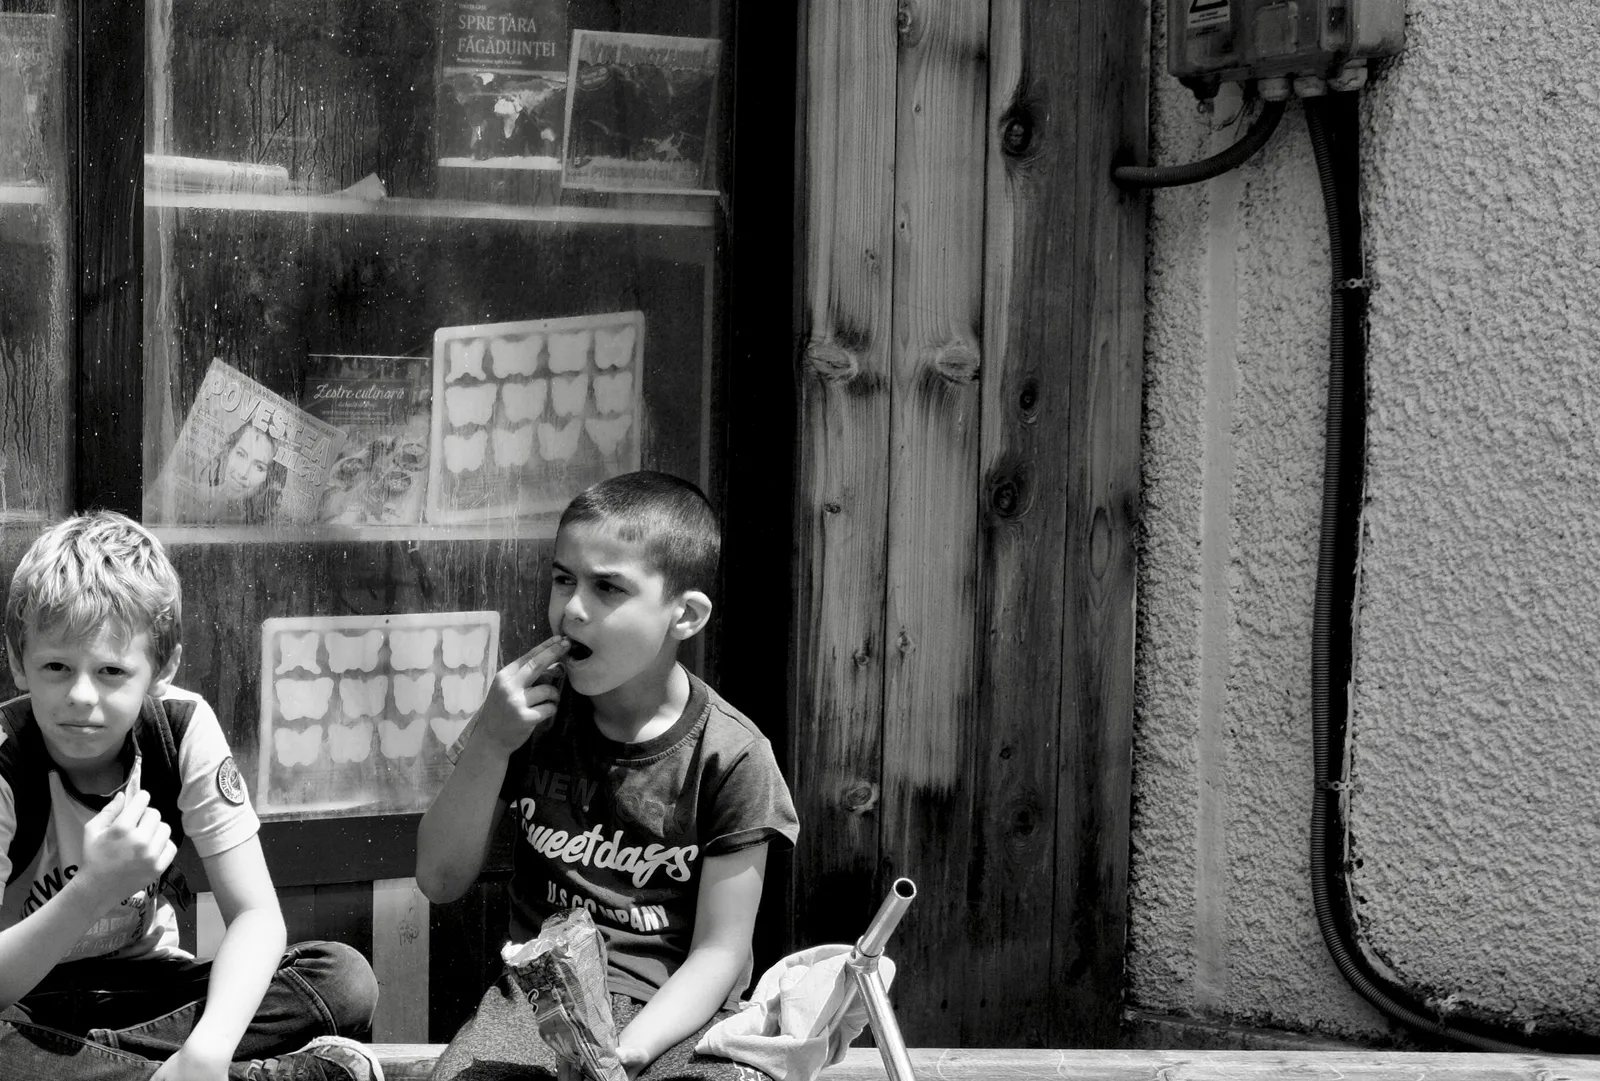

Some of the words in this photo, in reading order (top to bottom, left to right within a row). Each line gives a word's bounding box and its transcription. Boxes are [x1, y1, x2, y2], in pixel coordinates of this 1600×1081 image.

[459, 14, 495, 31] SPRE
[499, 15, 537, 35] ȚARA
[458, 35, 557, 60] FĂGĂDUINȚEI
[313, 384, 354, 400] Zestre
[203, 373, 332, 472] POVESTEA
[273, 446, 323, 487] mea
[528, 765, 599, 808] NEW
